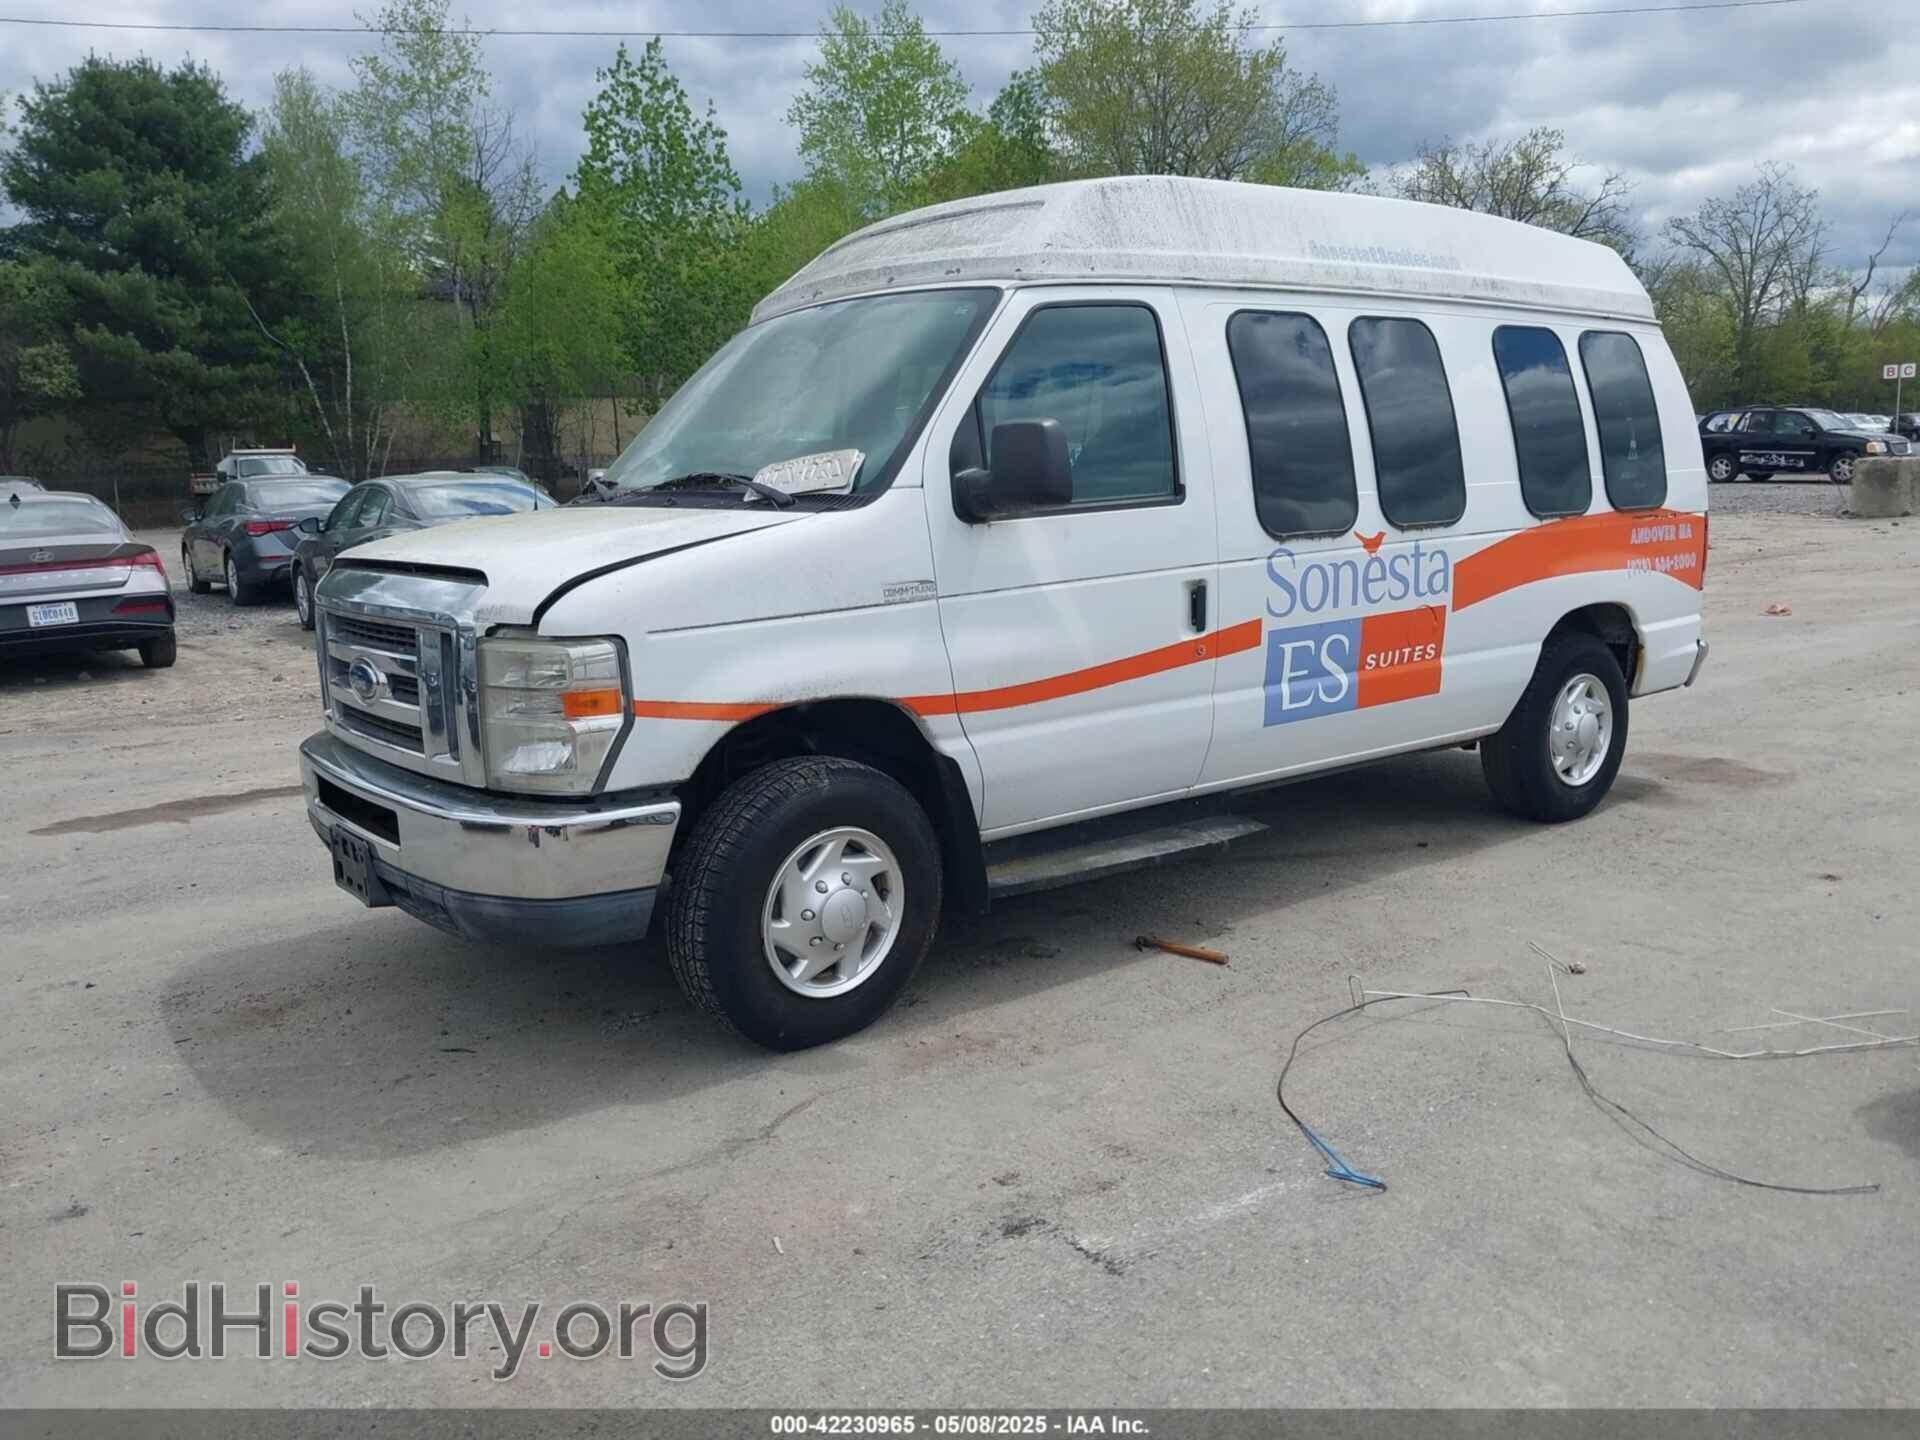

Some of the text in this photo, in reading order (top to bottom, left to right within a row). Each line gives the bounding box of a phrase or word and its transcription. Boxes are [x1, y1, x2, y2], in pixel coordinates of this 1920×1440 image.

[1630, 524, 1676, 545] ANDOVER
[1266, 541, 1449, 618] Sonesta
[1279, 633, 1350, 711] ES
[1364, 643, 1436, 671] SUITES
